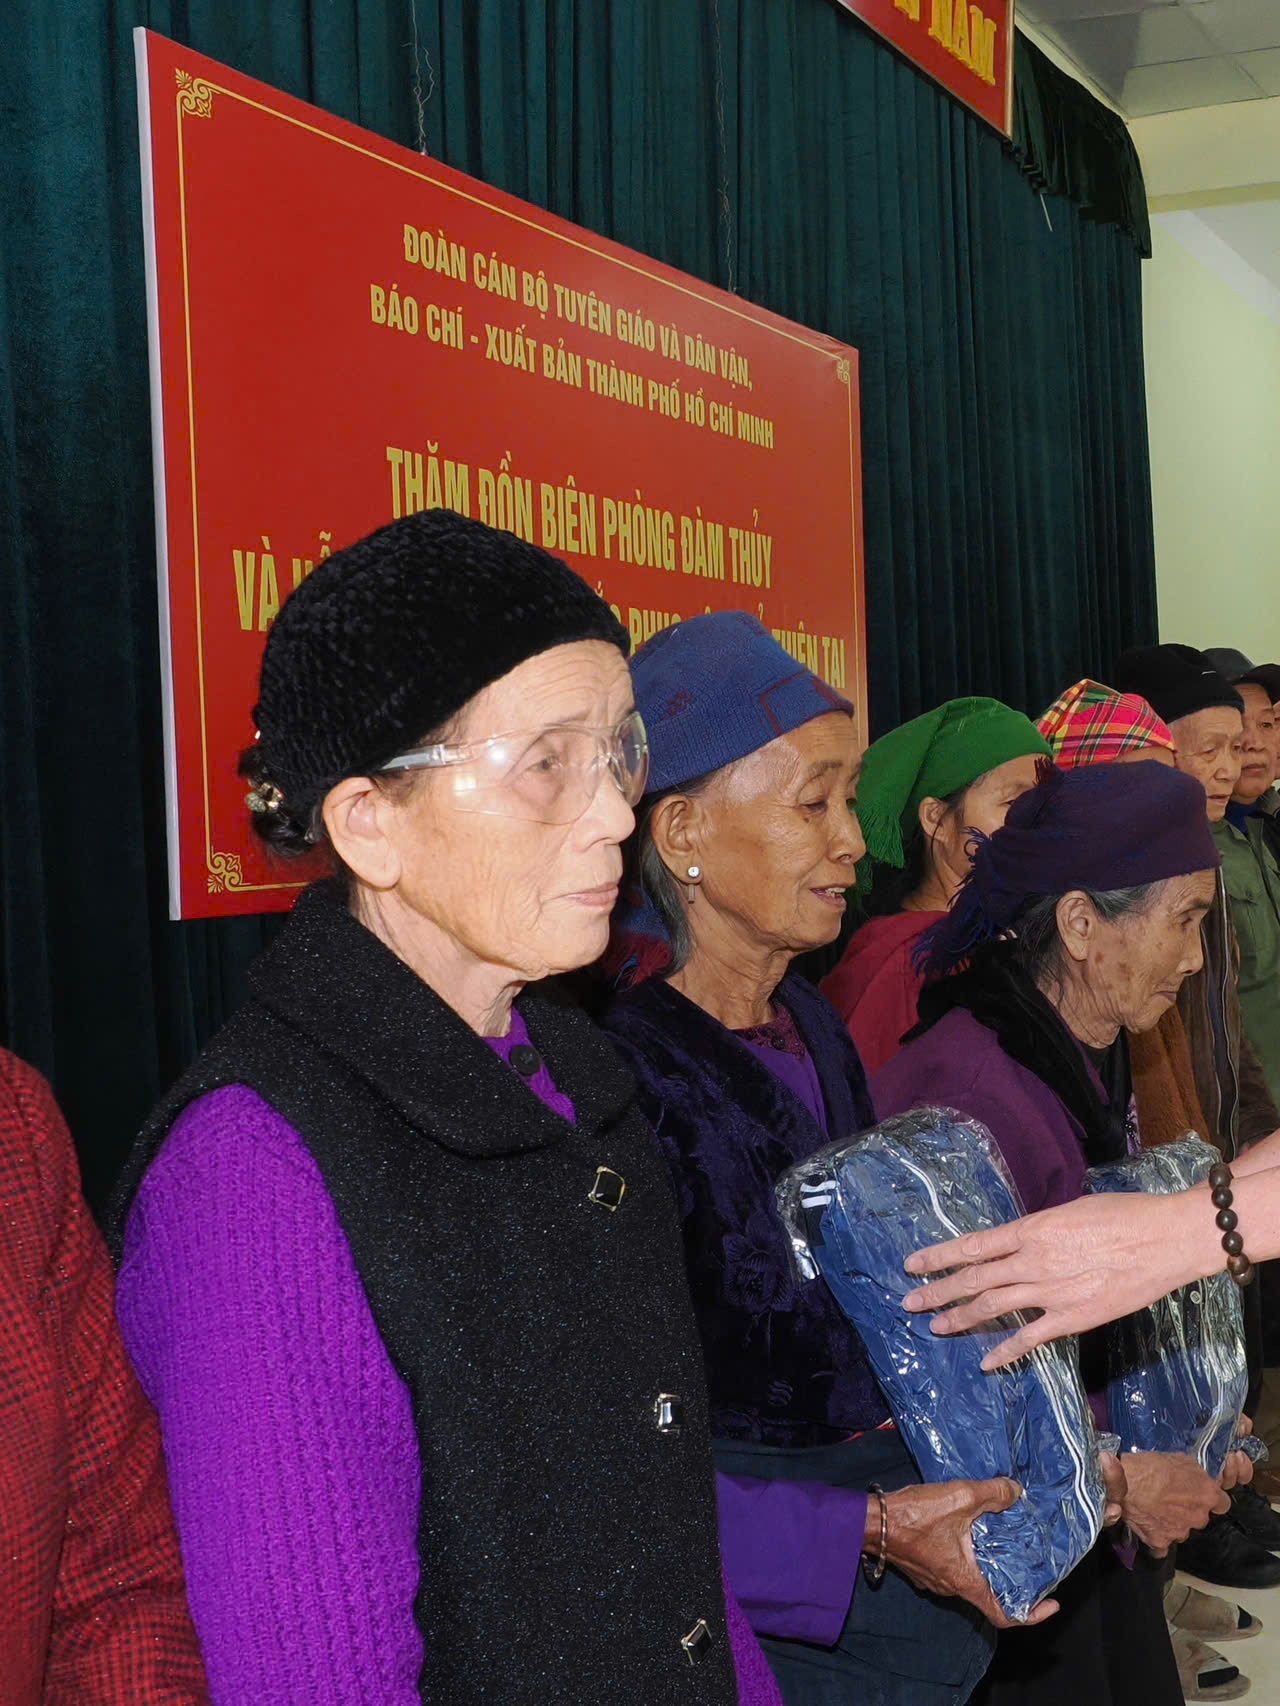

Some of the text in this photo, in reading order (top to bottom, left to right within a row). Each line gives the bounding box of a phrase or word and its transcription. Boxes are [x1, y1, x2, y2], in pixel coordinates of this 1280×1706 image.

[370, 283, 775, 450] BÁO CHÍ - XUẤT BẢN THÀNH PHỐ HỒ CHÍ MINH
[403, 223, 753, 392] ĐOÀN CÁN BỘ TUYÊN GIÁO VÀ DÂN VẬN,
[386, 439, 773, 589] THĂM ĐỒN BIÊN PHÒNG ĐÀM THỦY
[232, 535, 280, 632] VÀ
[822, 636, 847, 689] TAI
